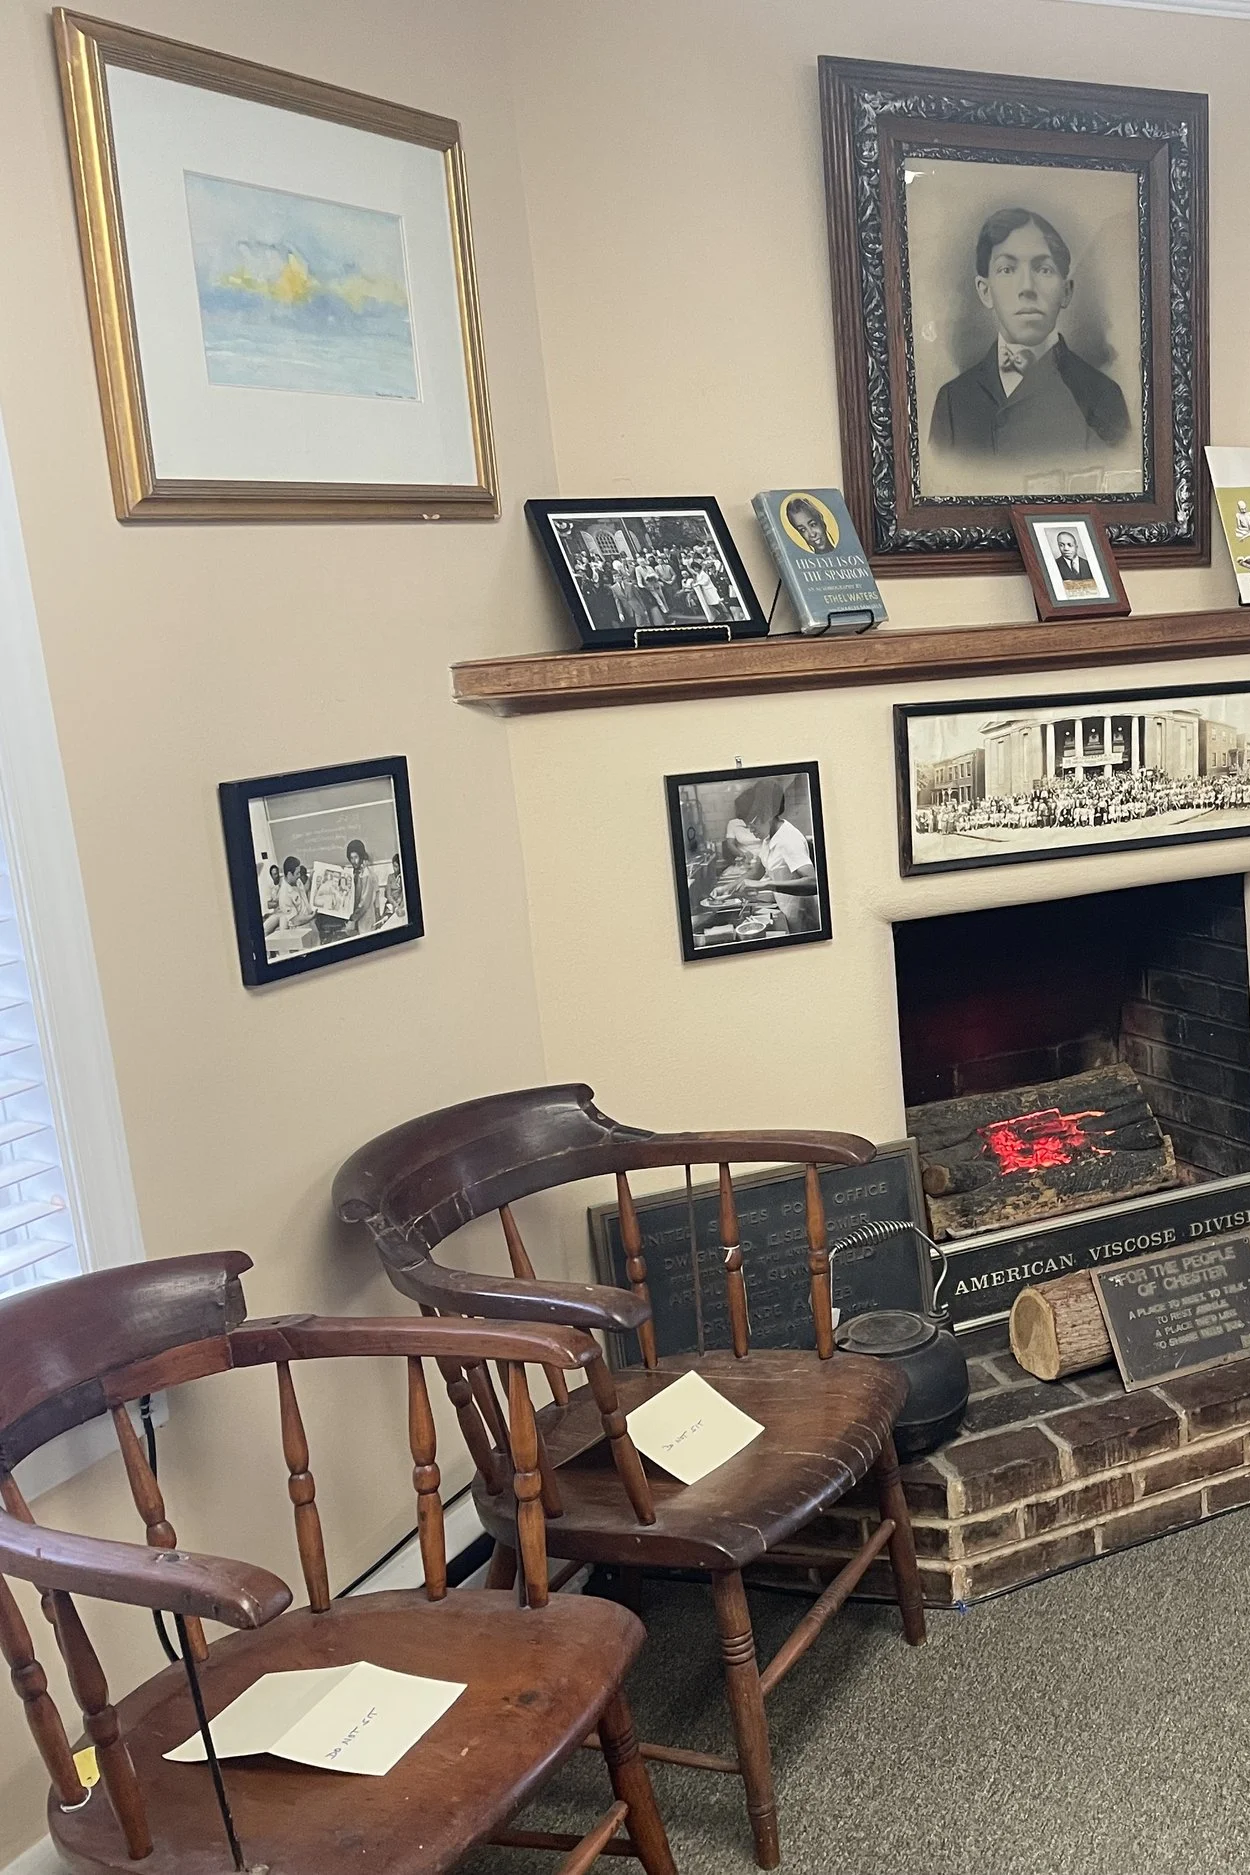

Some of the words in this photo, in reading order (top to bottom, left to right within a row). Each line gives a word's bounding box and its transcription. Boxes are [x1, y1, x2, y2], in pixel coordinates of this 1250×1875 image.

[824, 567, 869, 581] SPARROW
[824, 592, 848, 604] ETHEL
[847, 591, 879, 602] WATERS
[708, 1209, 768, 1234] STES
[834, 1181, 888, 1205] OFFICE
[664, 1245, 724, 1271] DWGH
[768, 1212, 870, 1247] EISEOWER
[954, 1253, 1075, 1296] AMERICAN
[1089, 1228, 1177, 1262] VISCOSE
[1117, 1268, 1148, 1287] FOR
[1149, 1260, 1180, 1278] THE
[1181, 1246, 1237, 1271] PEOPLE
[1137, 1281, 1157, 1297] OF
[1163, 1264, 1229, 1290] CHESTER
[1128, 1310, 1136, 1320] A
[1136, 1303, 1167, 1318] PLACE
[1168, 1299, 1180, 1309] TO
[1208, 1288, 1221, 1298] TO
[1156, 1314, 1168, 1325] TO
[1169, 1307, 1193, 1321] REST
[1155, 1329, 1162, 1338] A
[1164, 1320, 1194, 1335] PLACE
[1153, 1340, 1167, 1350] TO
[342, 1726, 360, 1746] NOT
